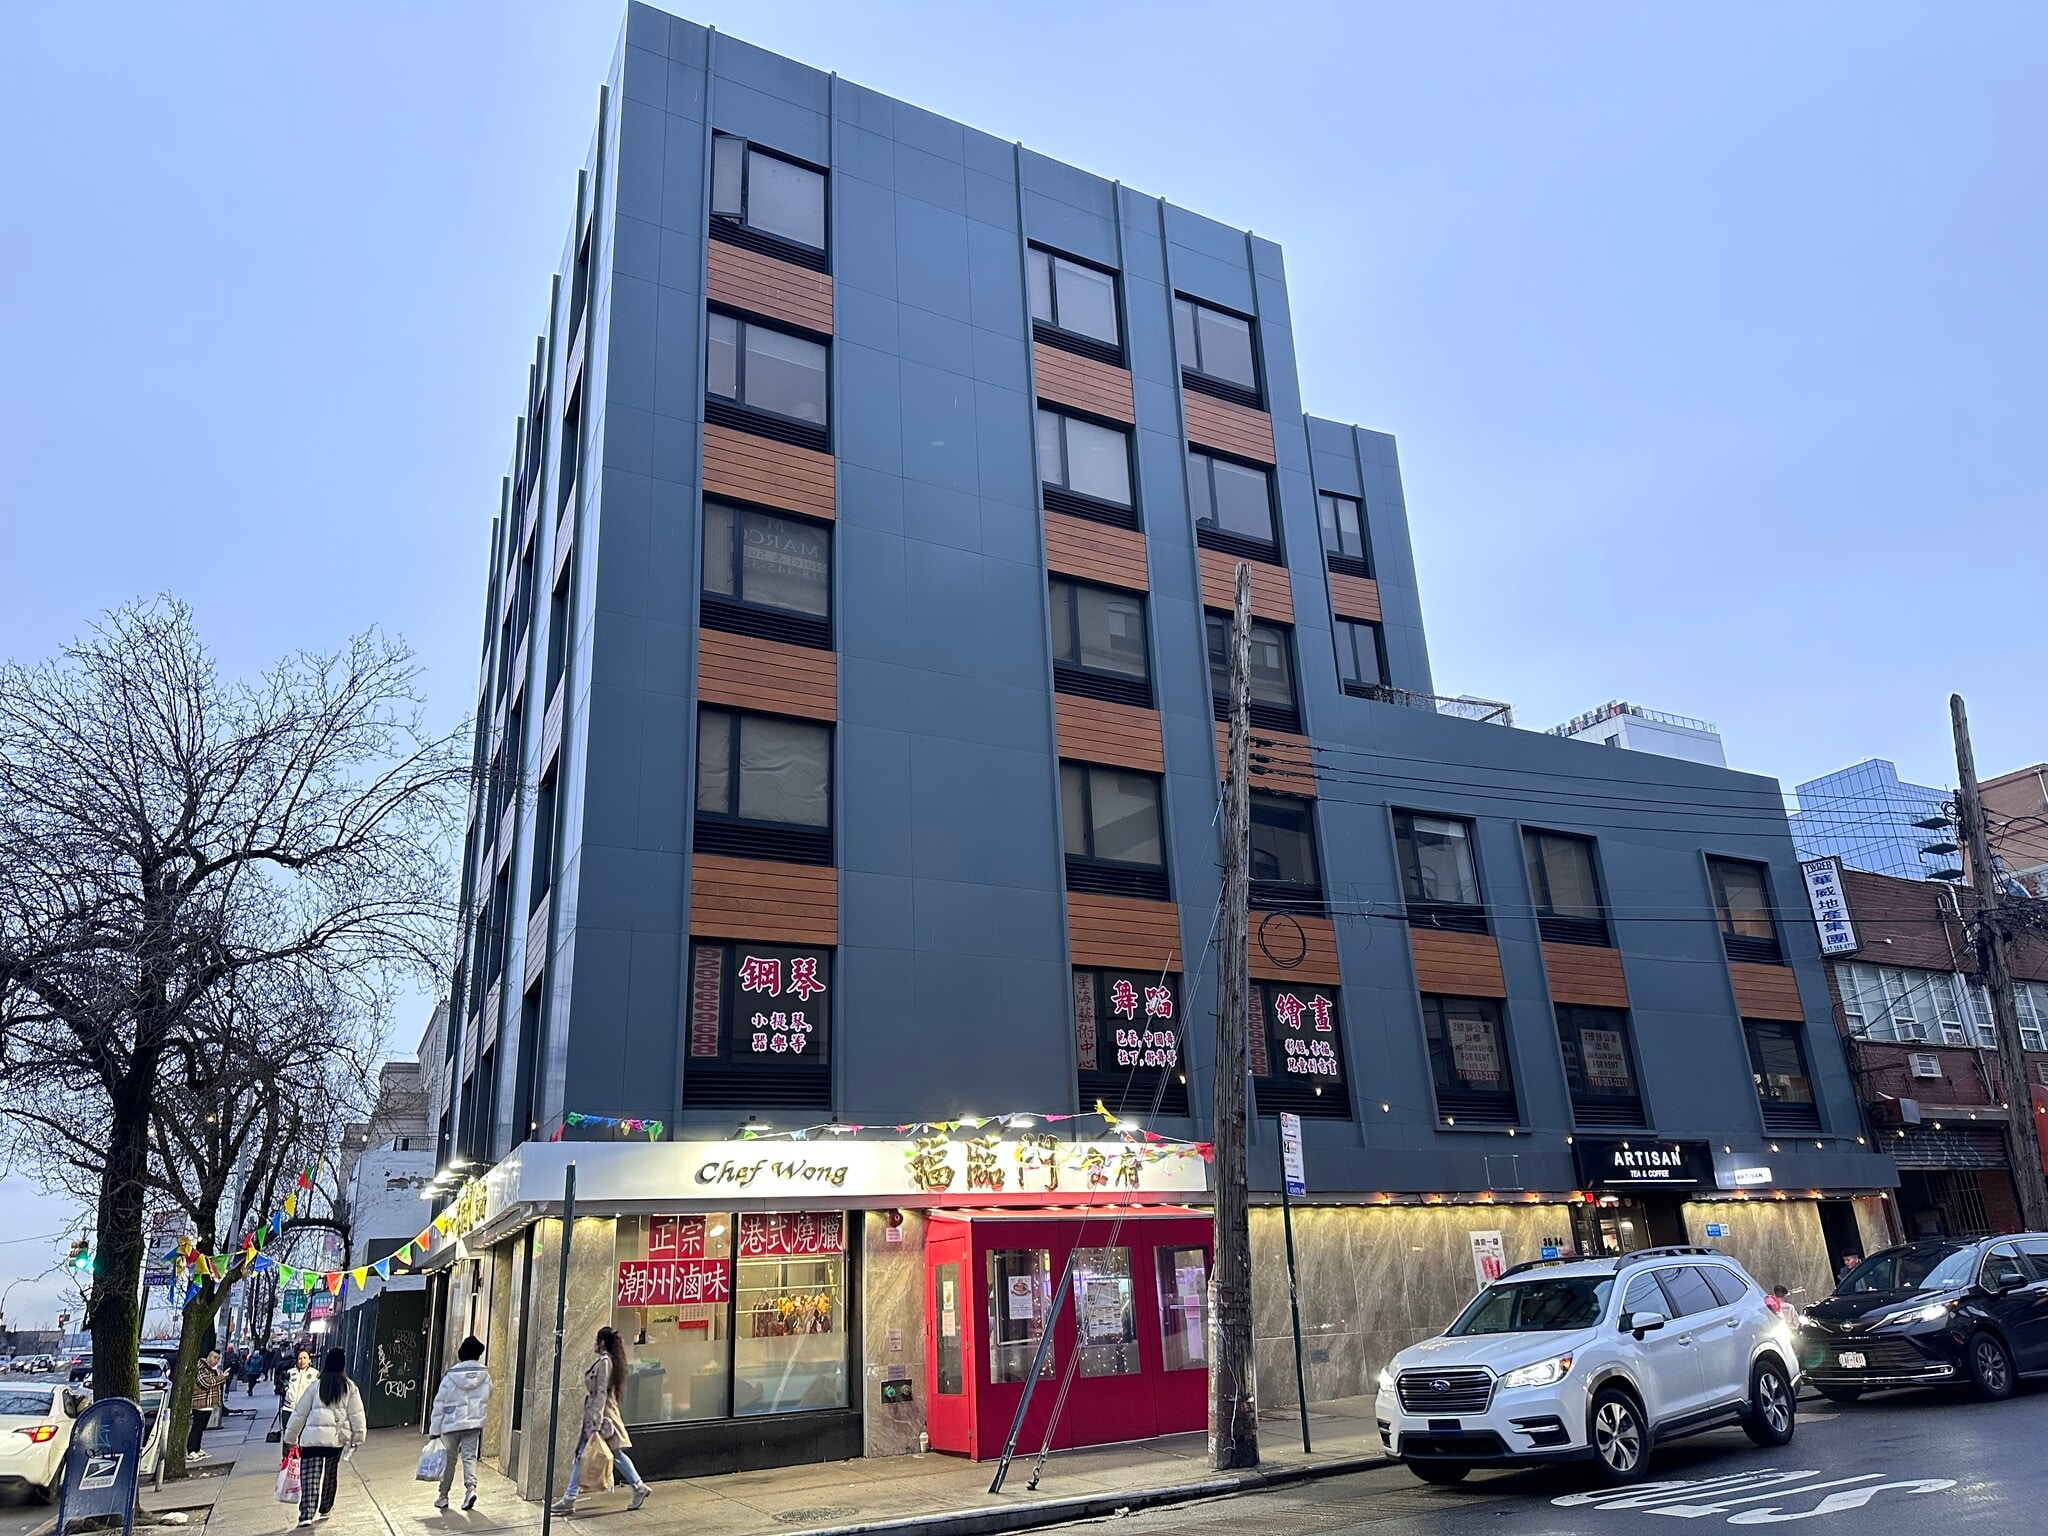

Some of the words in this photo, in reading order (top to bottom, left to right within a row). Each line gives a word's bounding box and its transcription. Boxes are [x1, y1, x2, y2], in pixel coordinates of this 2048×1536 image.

[738, 955, 827, 1001] 鋼琴
[693, 949, 721, 1056] 9296669688
[1110, 979, 1173, 1020] 舞蹈
[1275, 993, 1333, 1032] 繪畫
[1076, 974, 1096, 1069] 星海藝術中心
[1461, 1053, 1473, 1061] FOR
[1474, 1053, 1490, 1062] RENT
[1593, 1060, 1602, 1068] FOR
[1602, 1061, 1619, 1070] RENT
[695, 1159, 768, 1188] Chef
[771, 1159, 848, 1188] Wong
[1614, 1151, 1682, 1166] ARTISAN
[1648, 1170, 1670, 1178] COFFEE
[1737, 1172, 1763, 1180] ARTISAN
[649, 1220, 703, 1256] 正宗
[740, 1215, 843, 1253] 港式燒臘
[618, 1262, 730, 1304] 潮州滷味
